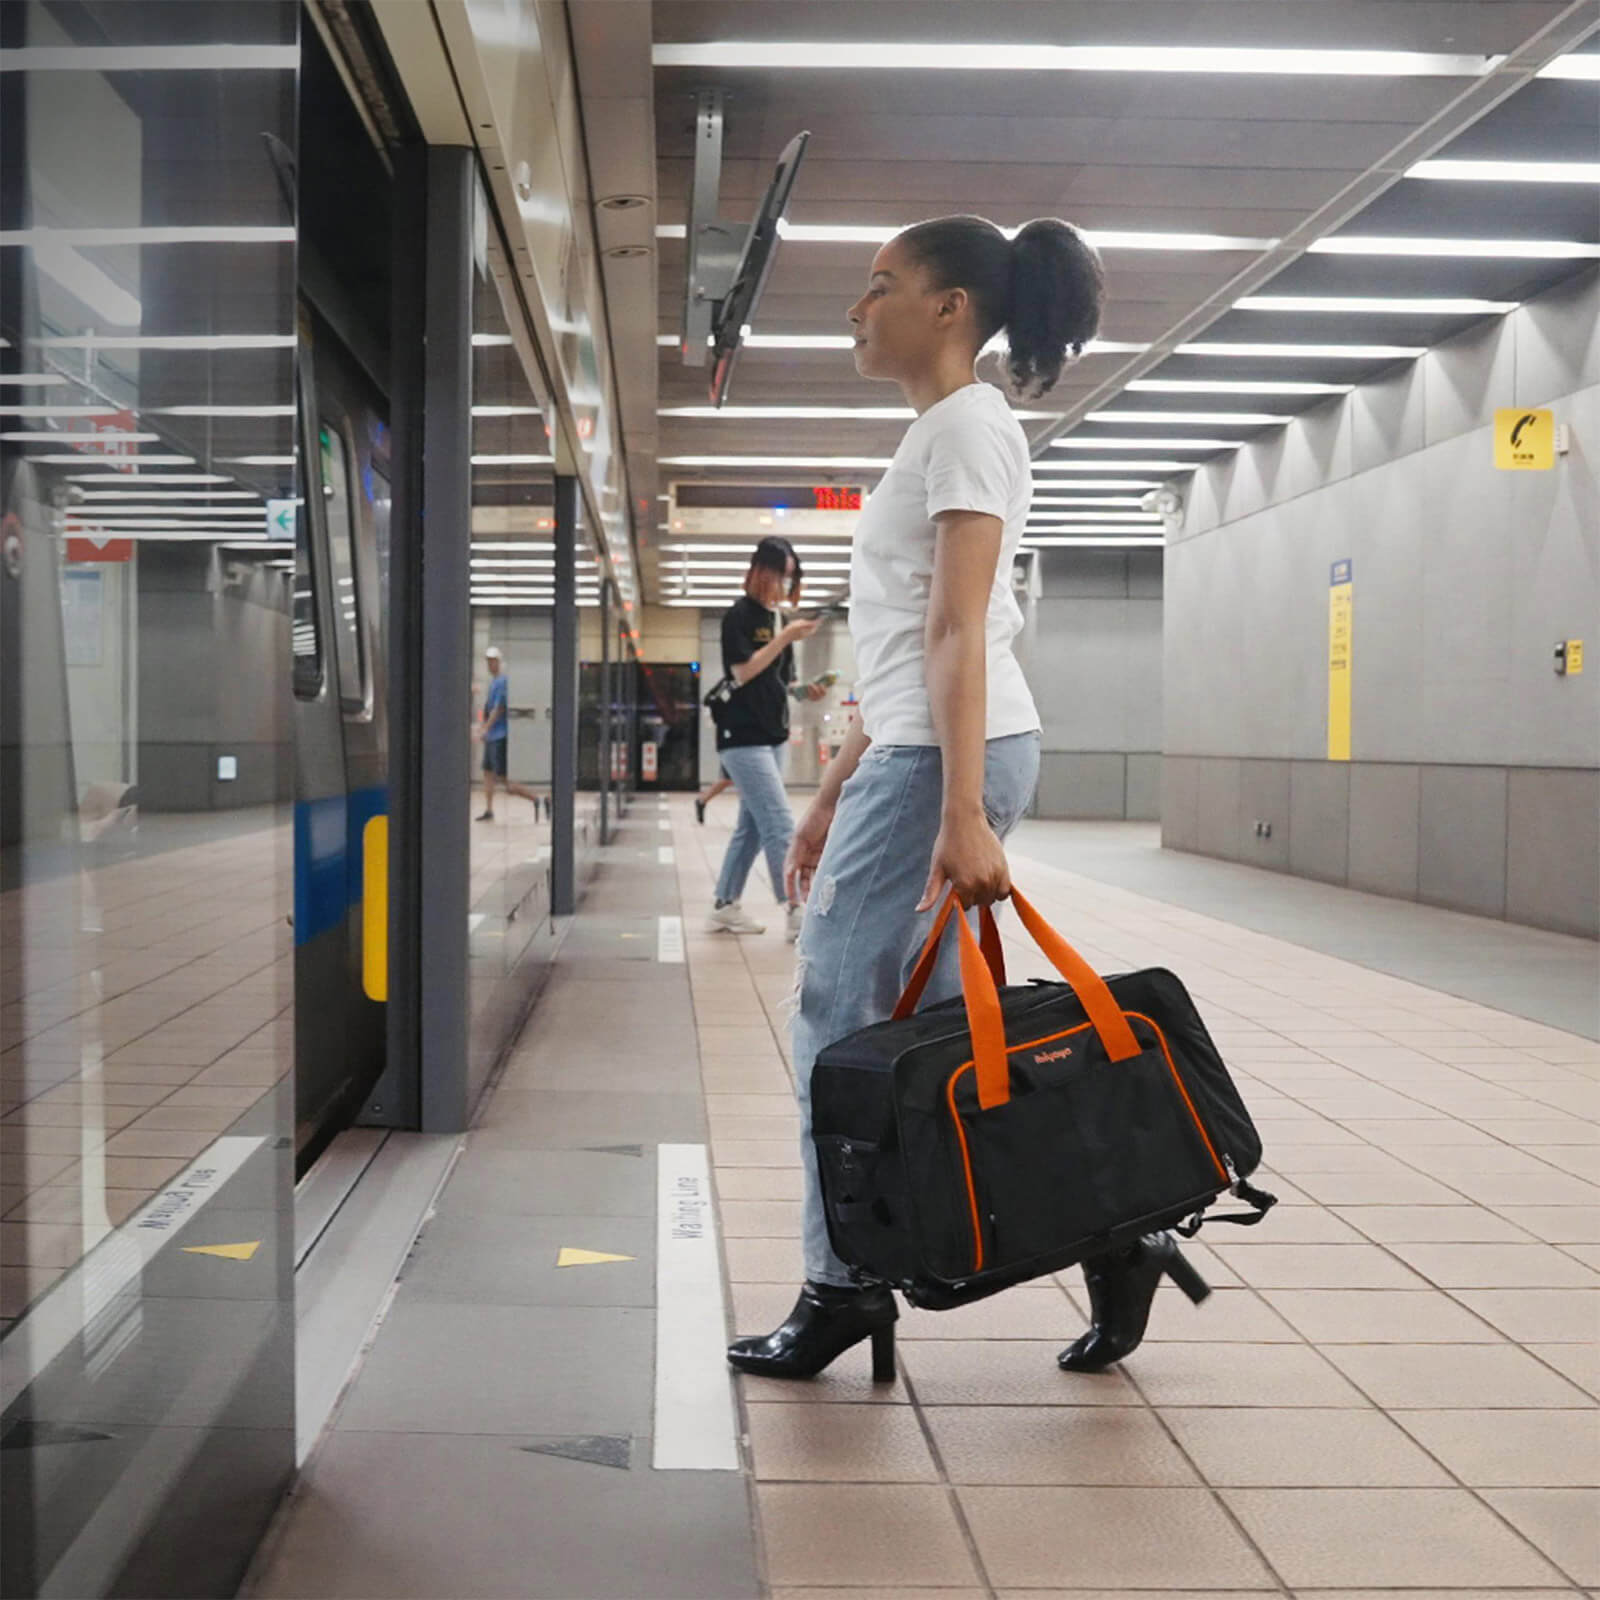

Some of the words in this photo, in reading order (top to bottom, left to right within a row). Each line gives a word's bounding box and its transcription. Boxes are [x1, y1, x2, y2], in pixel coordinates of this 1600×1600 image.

[813, 486, 861, 510] This
[672, 1177, 700, 1197] Line
[672, 1200, 707, 1239] Waiting
